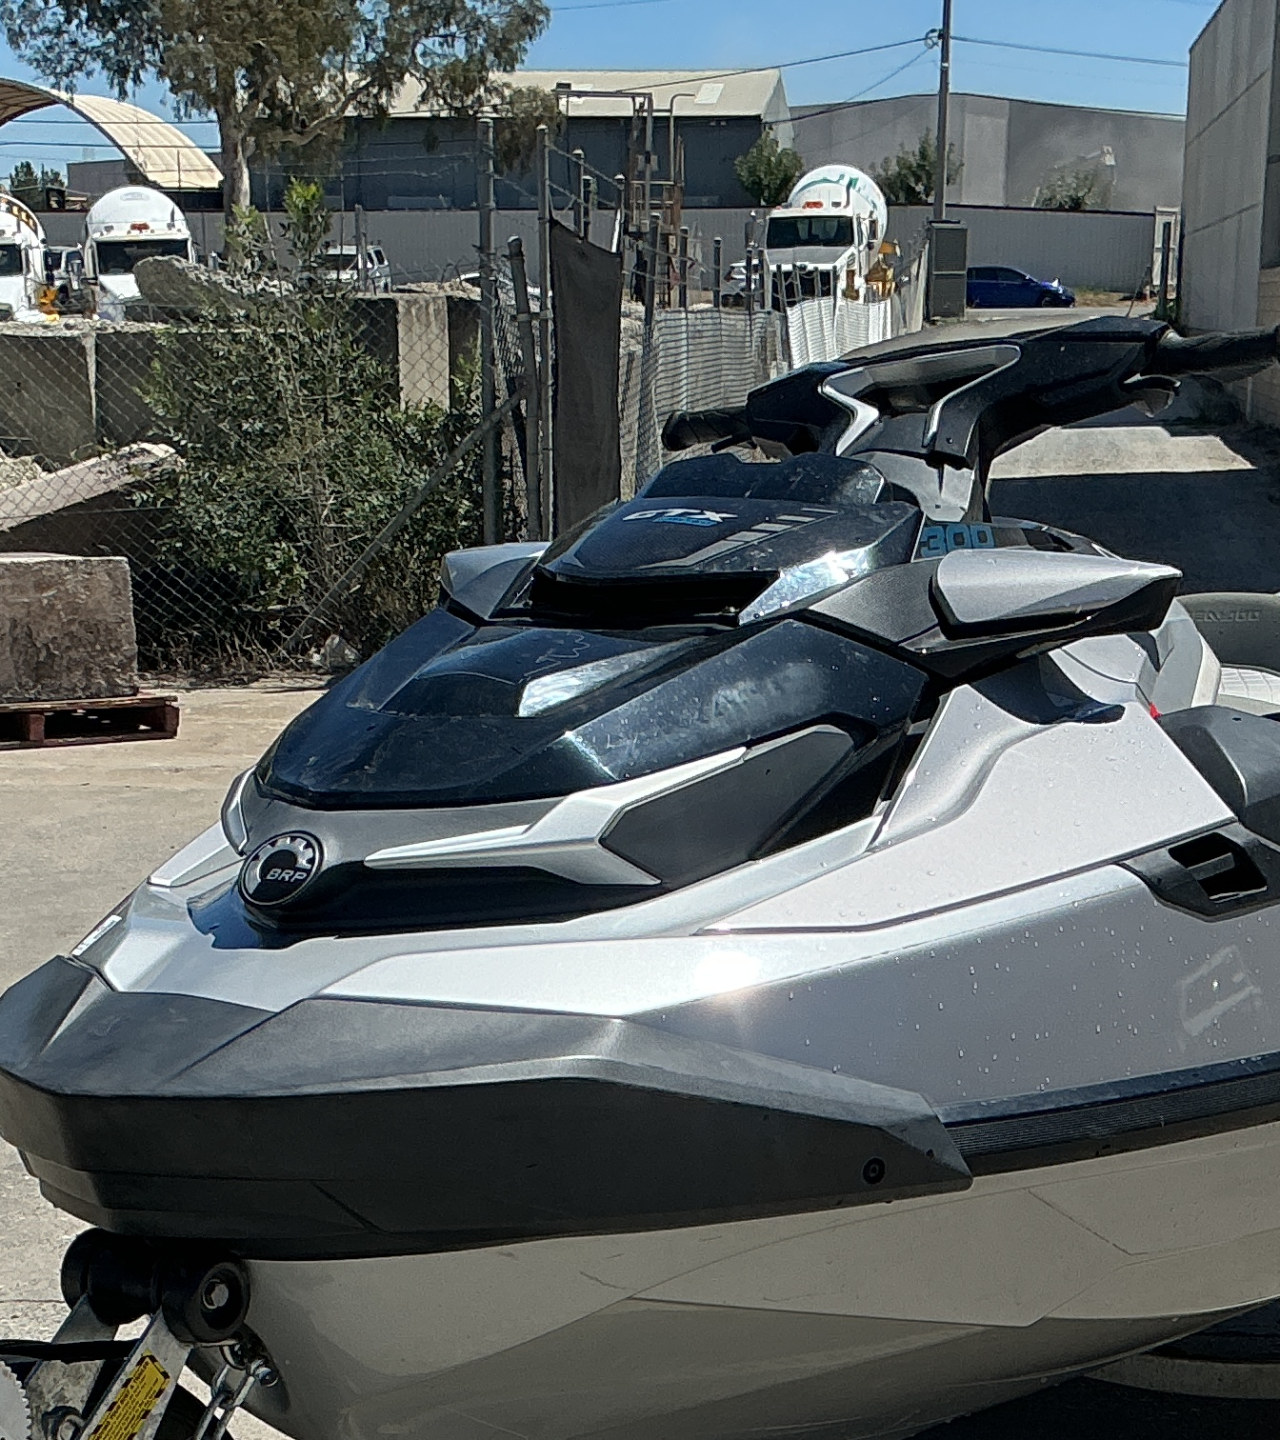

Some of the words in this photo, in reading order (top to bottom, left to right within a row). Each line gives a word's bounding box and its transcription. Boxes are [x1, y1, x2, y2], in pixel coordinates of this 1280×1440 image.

[622, 508, 739, 523] GTX
[922, 523, 995, 558] 300
[266, 868, 307, 883] BRP
